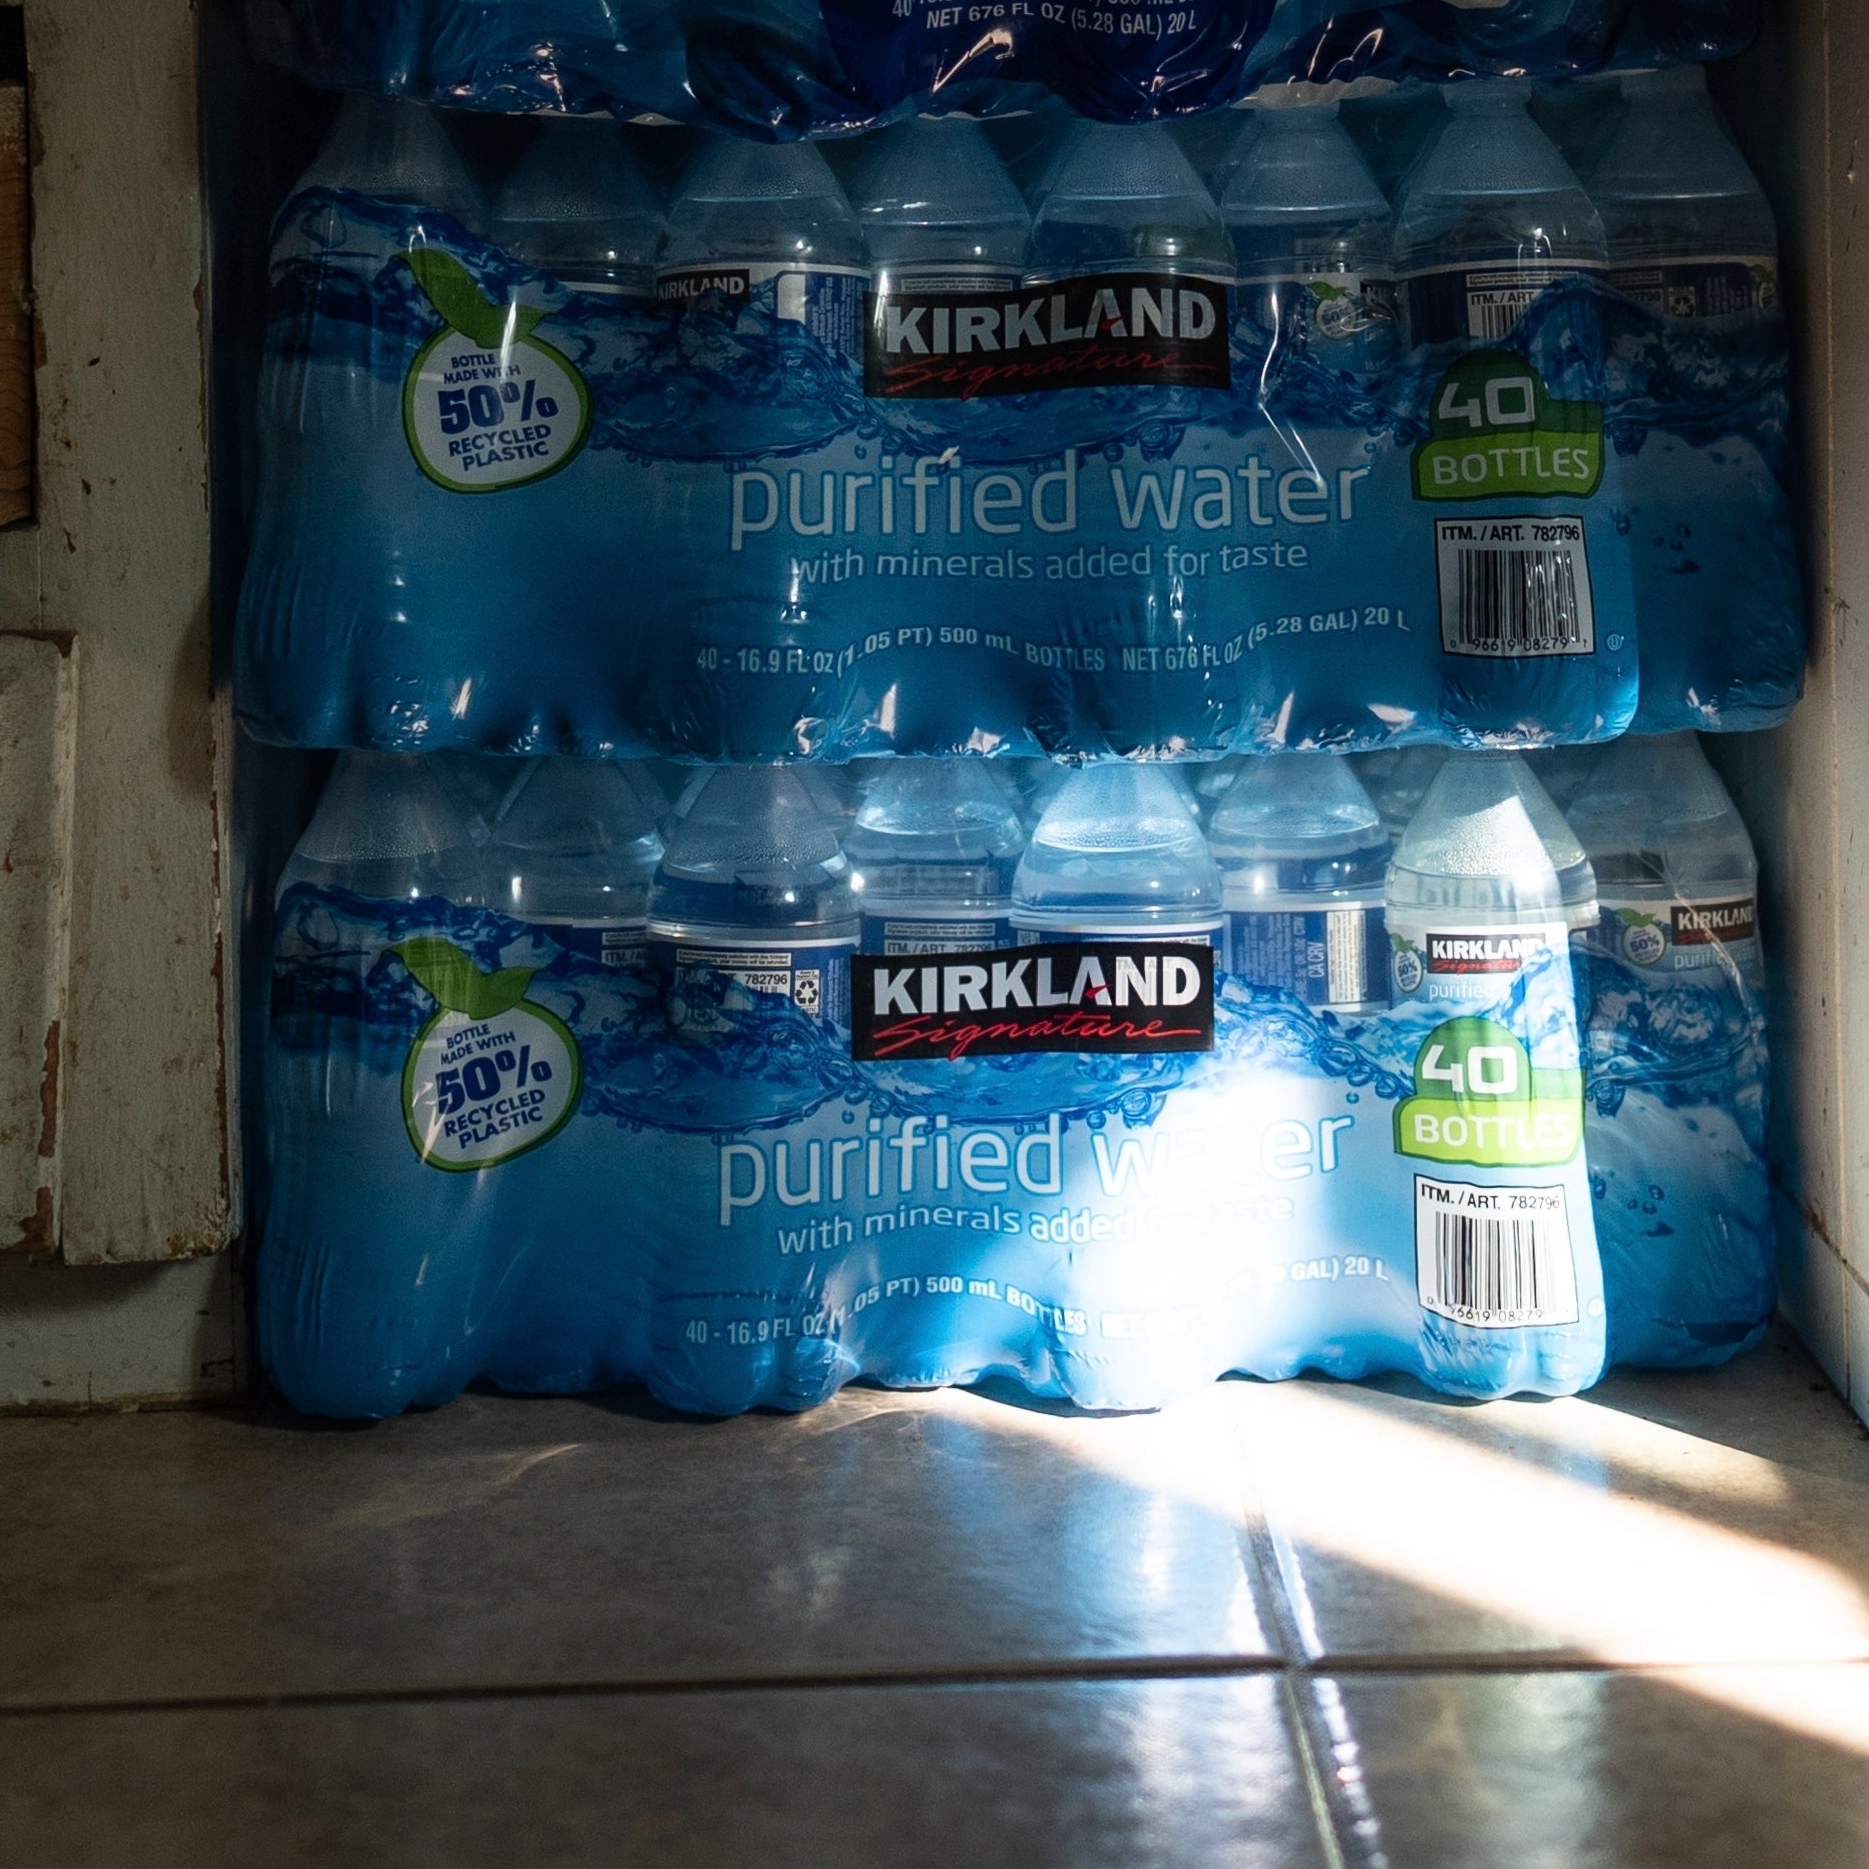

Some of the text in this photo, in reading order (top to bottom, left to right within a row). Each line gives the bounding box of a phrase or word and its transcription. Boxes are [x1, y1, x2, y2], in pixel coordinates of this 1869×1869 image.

[926, 1, 1197, 41] NET 676 FL OZ (5.28 GAL) 20 L
[658, 276, 745, 303] KIRKLAND
[886, 288, 1217, 354] KIRKLAND
[444, 365, 521, 384] MADE WIH
[451, 354, 495, 369] BOTTLE
[882, 344, 1219, 401] Signature
[438, 380, 559, 434] 50%
[1438, 376, 1536, 428] 40
[449, 425, 551, 457] RECYCLED
[462, 441, 549, 471] PLASTIC
[1433, 446, 1589, 485] BOTTLES
[731, 448, 1370, 551] purified water
[1442, 525, 1580, 542] ITM. / ART. 782796
[793, 541, 1309, 585] with minerals added for taste
[697, 606, 1411, 679] 40 16.9 FL OZ (1.05 PT) 500 mL BOTTLES NET 676 FL OZ (5.28 GAL) 20 L
[1473, 637, 1567, 652] 96619 08279
[1308, 941, 1325, 978] CA CRV
[1432, 938, 1545, 959] KIRKLAND
[1629, 935, 1661, 953] 50%
[744, 973, 788, 985] 782796
[873, 956, 1202, 1015] KIRKLAND
[1397, 962, 1418, 978] 50%
[440, 1032, 516, 1065] MADE WITH
[446, 1023, 490, 1049] BOTTLE
[872, 1011, 1202, 1062] Signature
[435, 1045, 552, 1114] 50%
[1422, 1044, 1518, 1095] 40
[444, 1089, 545, 1137] RECYCLED
[459, 1107, 543, 1149] PLASTIC
[1414, 1113, 1572, 1150] BOTTLES
[718, 1113, 1063, 1227] purified
[1421, 1183, 1560, 1211] ITM. / ART. 782796
[778, 1214, 854, 1256] with
[865, 1203, 1021, 1235] minerals
[1031, 1207, 1138, 1245] added
[1291, 1255, 1390, 1283] GAL) 20 L
[686, 1319, 708, 1343] 40
[728, 1320, 769, 1345] 16.9
[773, 1318, 796, 1340] FL
[803, 1313, 826, 1336] OZ
[886, 1277, 920, 1298] PT)
[927, 1276, 962, 1294] 500
[968, 1279, 1002, 1300] mL
[1006, 1283, 1089, 1336] BOTTLES
[1498, 1308, 1544, 1323] 08279
